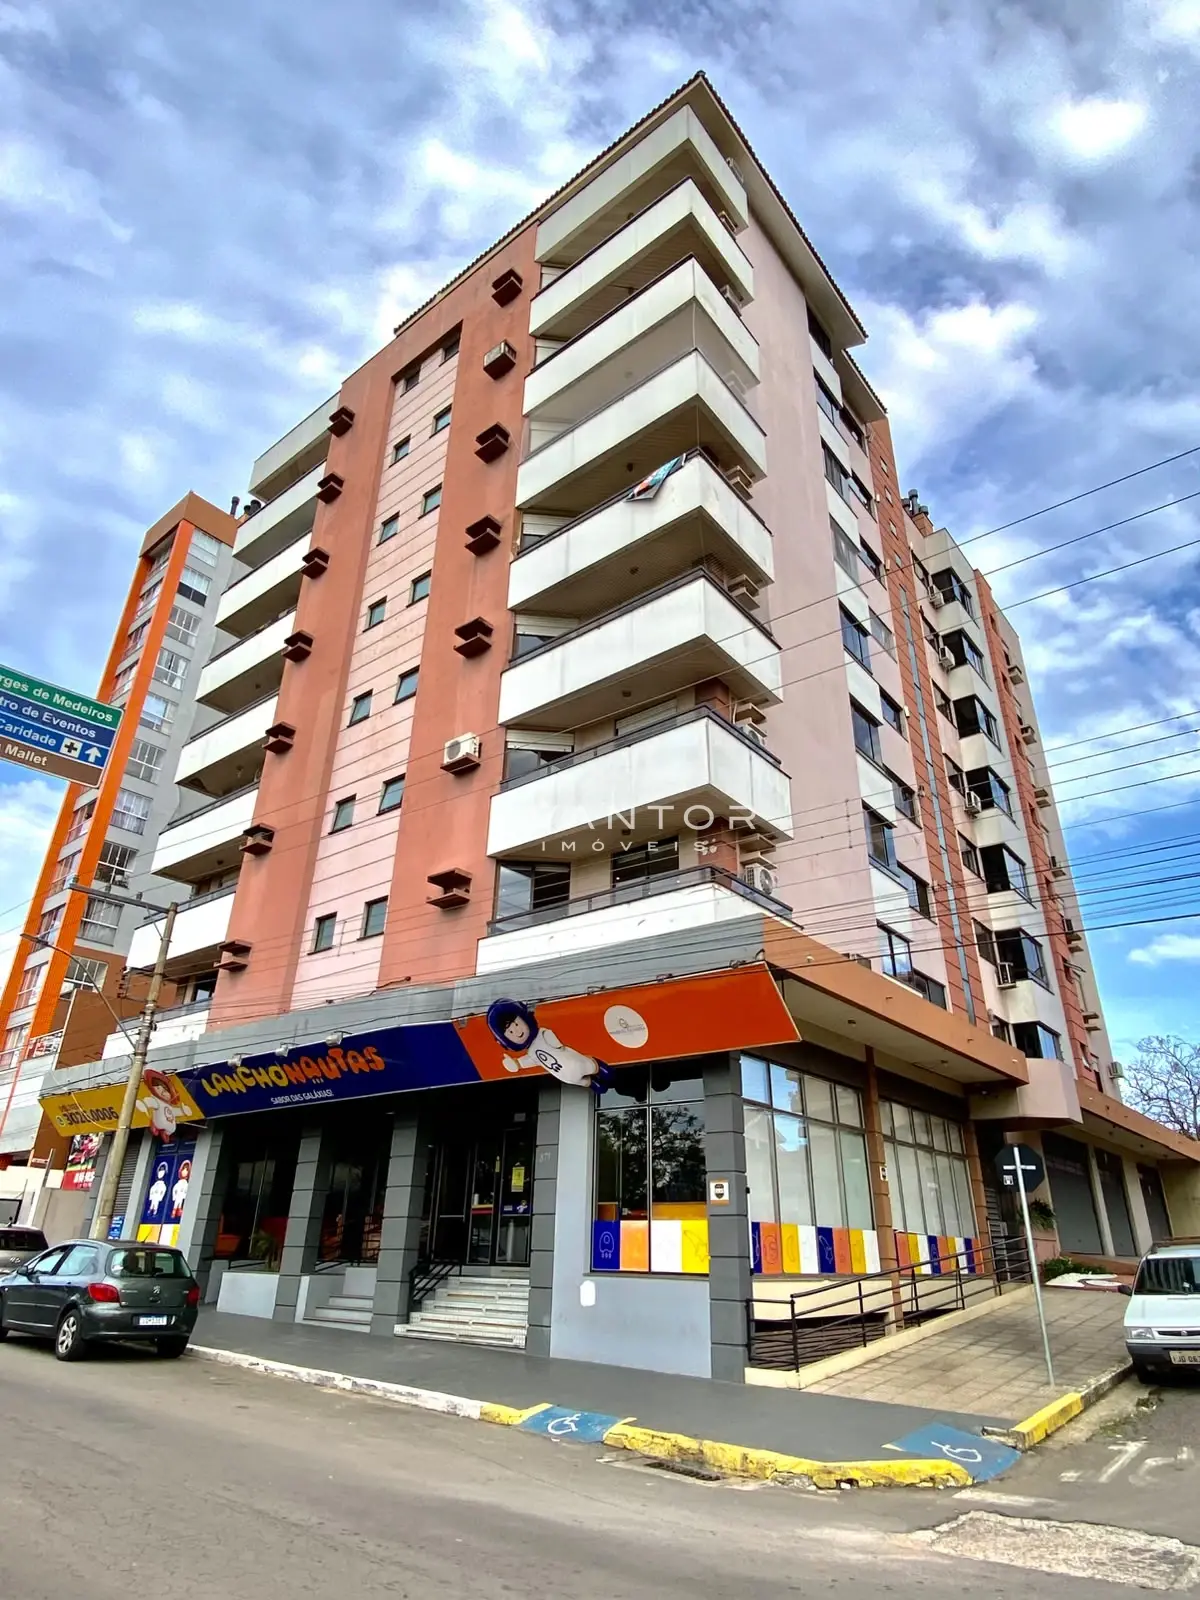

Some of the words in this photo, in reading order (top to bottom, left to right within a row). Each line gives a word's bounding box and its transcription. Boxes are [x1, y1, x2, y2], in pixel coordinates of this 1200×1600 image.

[33, 688, 50, 700] de
[53, 694, 113, 722] Medeiros
[22, 706, 39, 718] de
[42, 712, 97, 738] Eventos
[5, 744, 48, 766] Mallet
[202, 1046, 386, 1097] LANCHONAUTAS
[270, 1095, 291, 1105] SABOR
[290, 1093, 304, 1102] DAS
